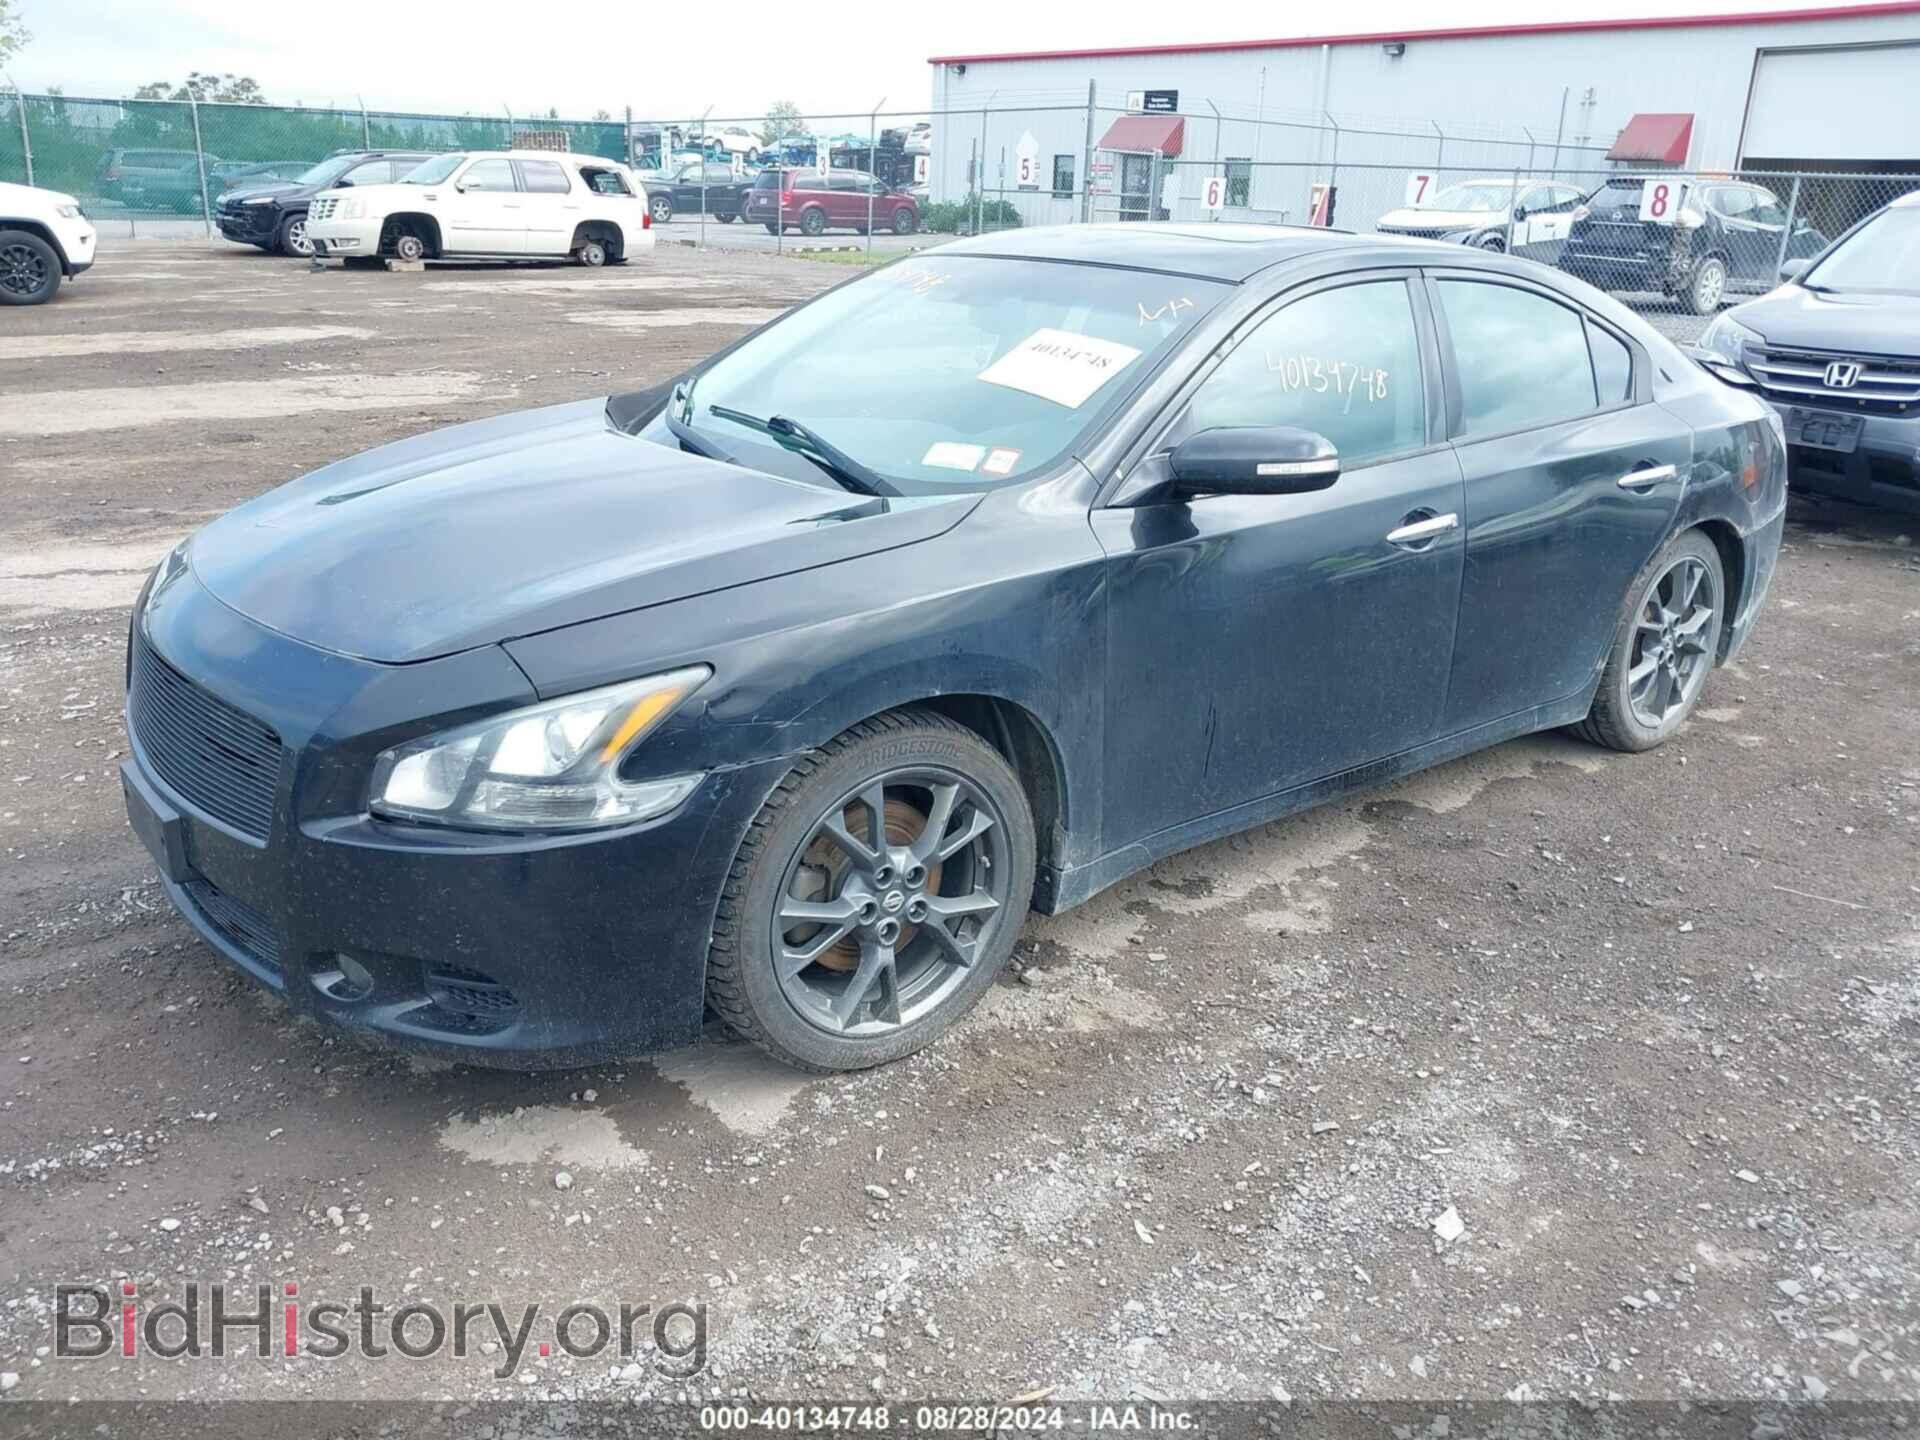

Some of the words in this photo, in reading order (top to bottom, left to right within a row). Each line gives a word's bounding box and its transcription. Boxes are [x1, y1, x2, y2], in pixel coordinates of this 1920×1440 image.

[820, 156, 826, 176] 3
[919, 159, 926, 179] 4
[1022, 158, 1029, 181] 5
[1207, 180, 1219, 206] 6
[1416, 175, 1430, 204] 7
[1650, 184, 1669, 217] 8
[1264, 351, 1389, 414] 40134748
